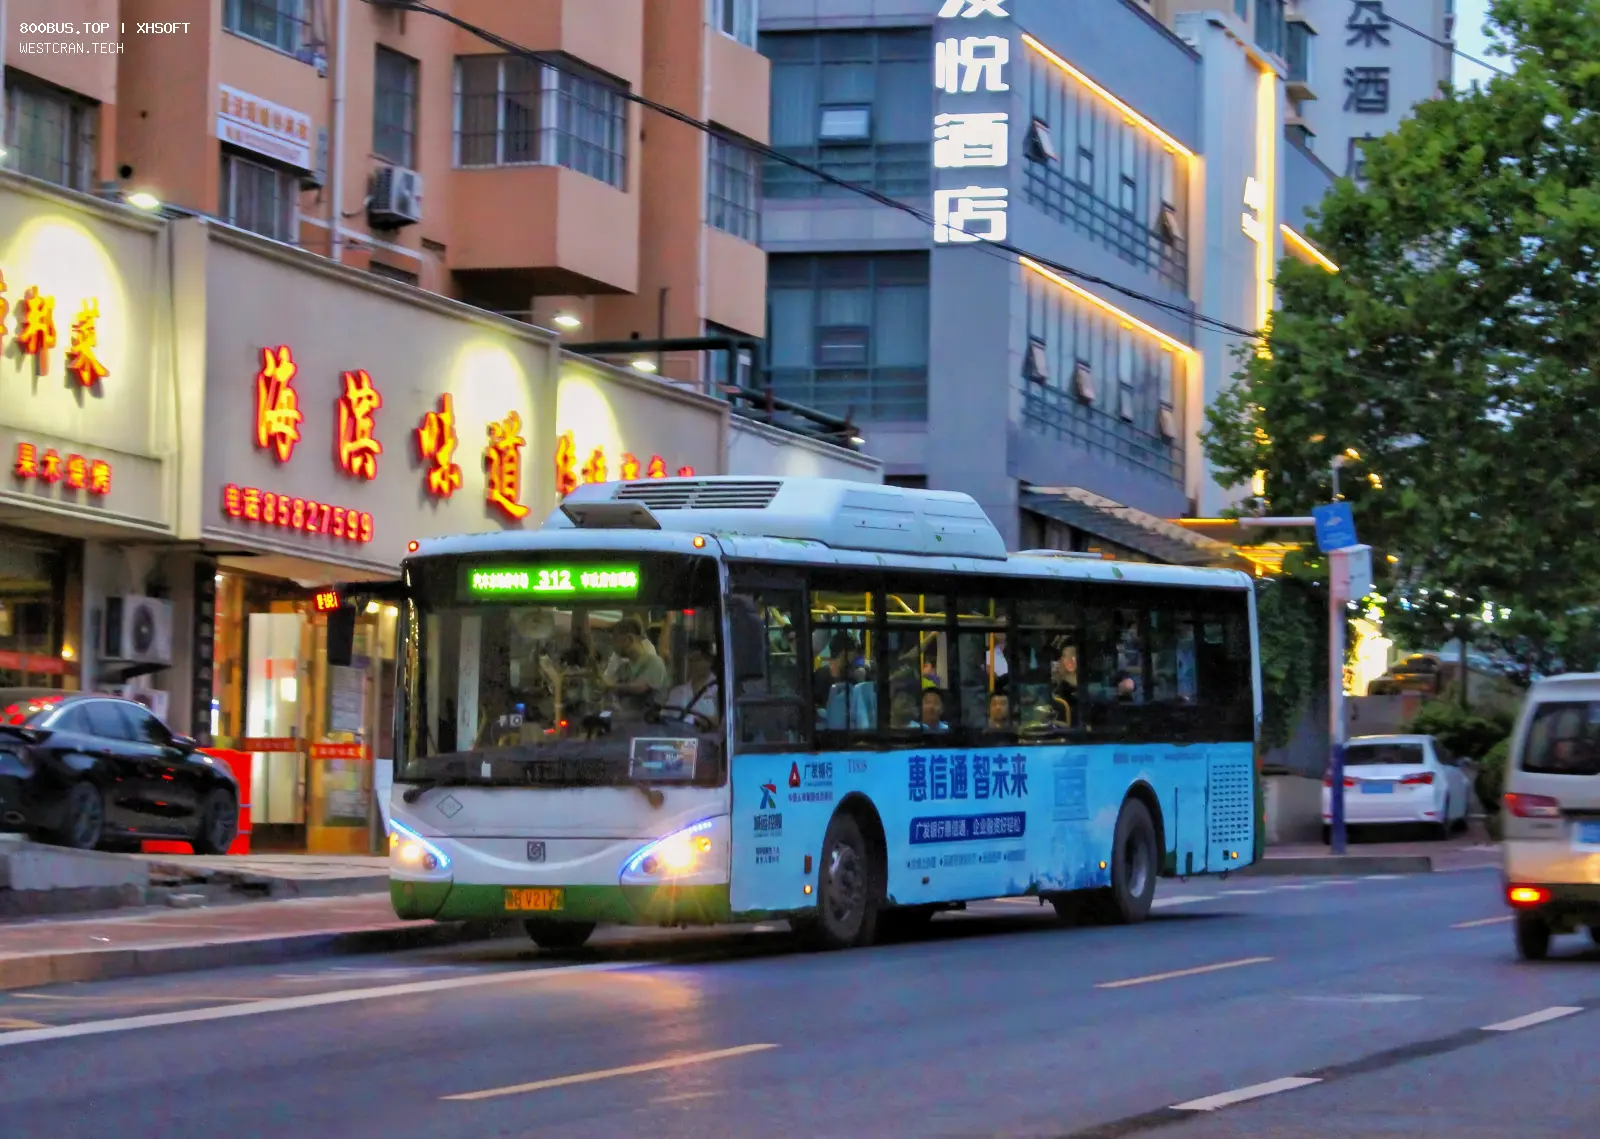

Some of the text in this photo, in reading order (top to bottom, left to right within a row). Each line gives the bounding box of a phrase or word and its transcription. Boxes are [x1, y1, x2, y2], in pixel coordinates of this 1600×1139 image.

[255, 345, 531, 520] 海滨味道
[537, 570, 573, 591] 312
